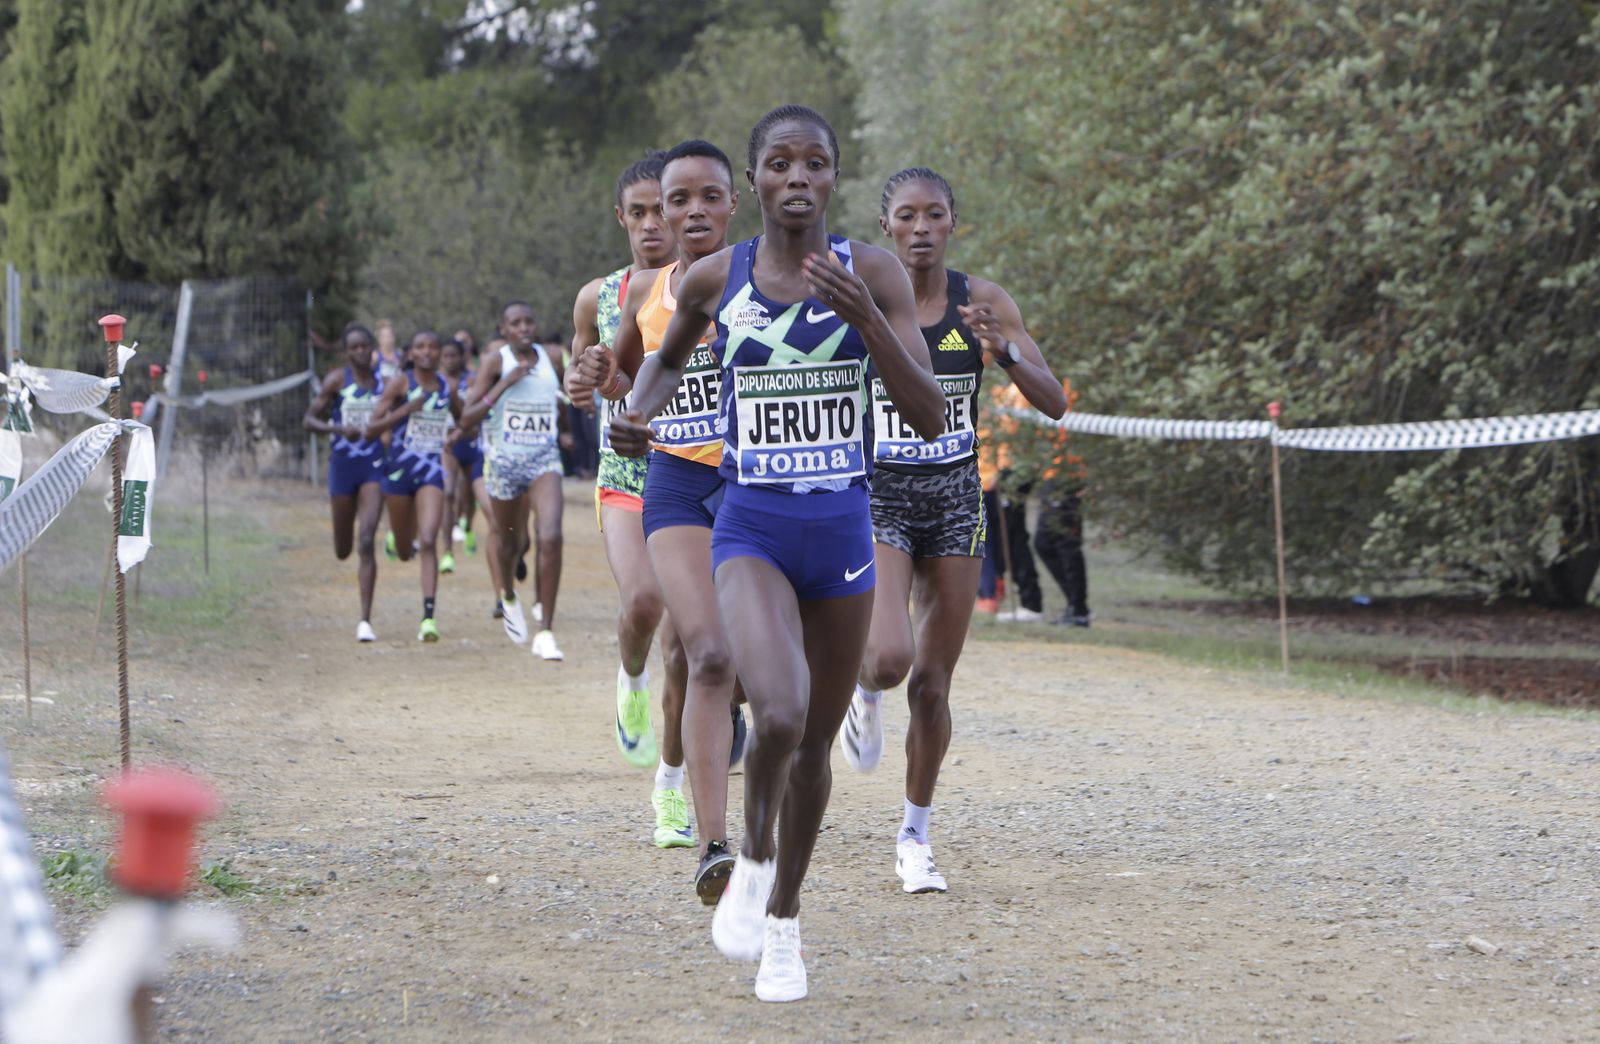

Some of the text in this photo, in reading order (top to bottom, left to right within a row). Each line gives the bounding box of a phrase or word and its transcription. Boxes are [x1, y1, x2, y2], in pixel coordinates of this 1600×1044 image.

[938, 342, 969, 351] adidas
[738, 368, 860, 392] DIPUTACION DE SEVILLA
[943, 380, 974, 393] SEVILLA
[508, 415, 551, 432] CAN
[748, 397, 856, 445] JERUTO
